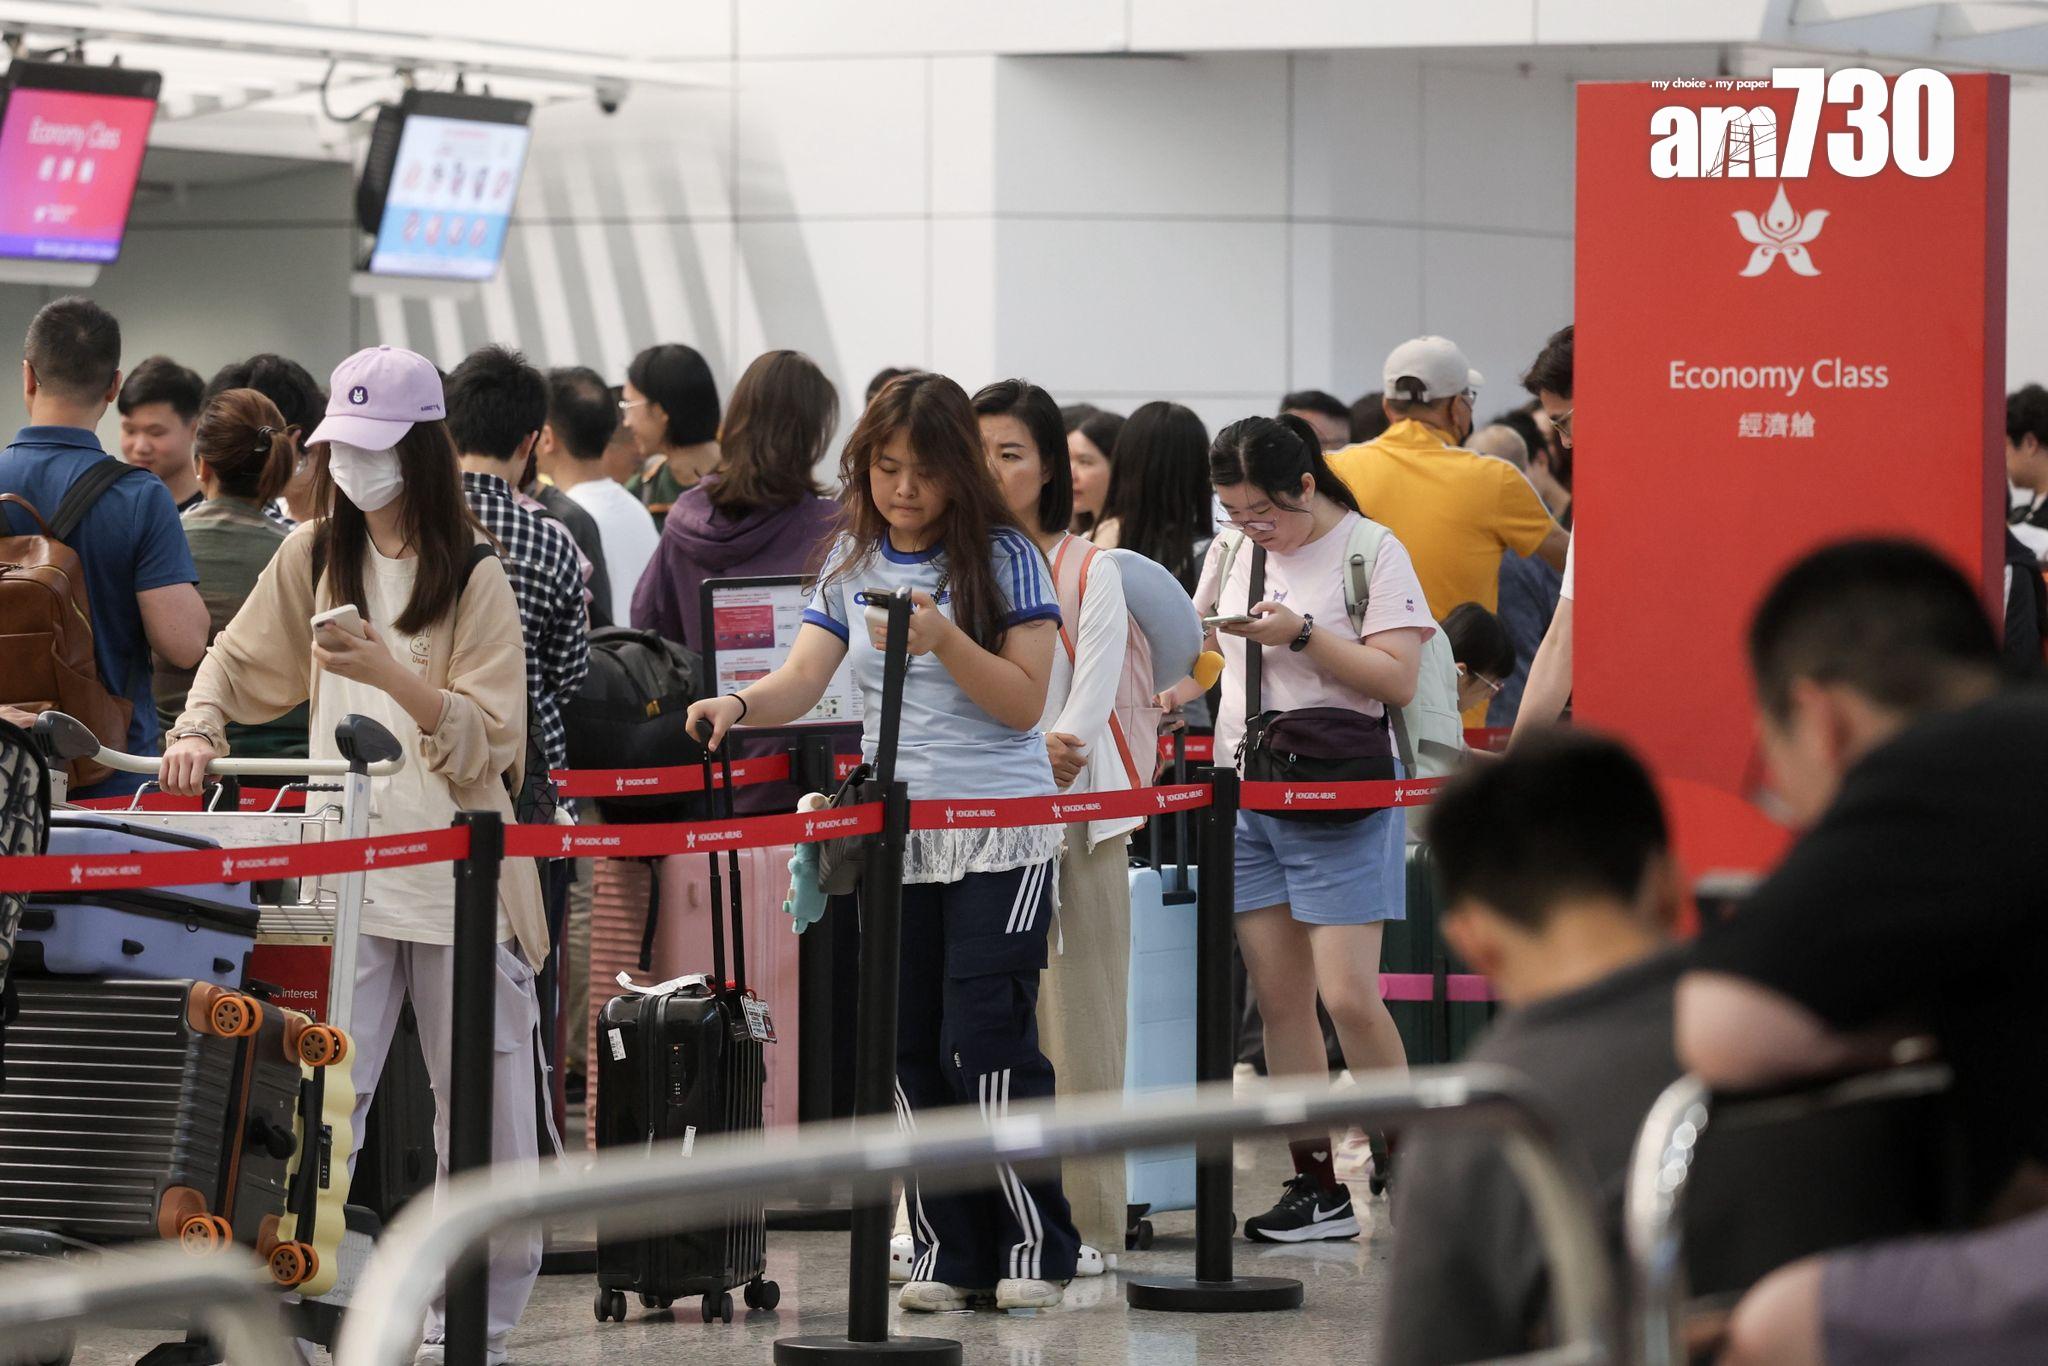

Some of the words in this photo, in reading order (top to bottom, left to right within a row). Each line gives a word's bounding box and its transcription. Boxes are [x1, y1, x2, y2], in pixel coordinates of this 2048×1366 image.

[1669, 360, 1805, 397] Economy
[1811, 357, 1889, 389] Class
[1738, 411, 1816, 438] 經濟艙
[282, 988, 318, 999] interest
